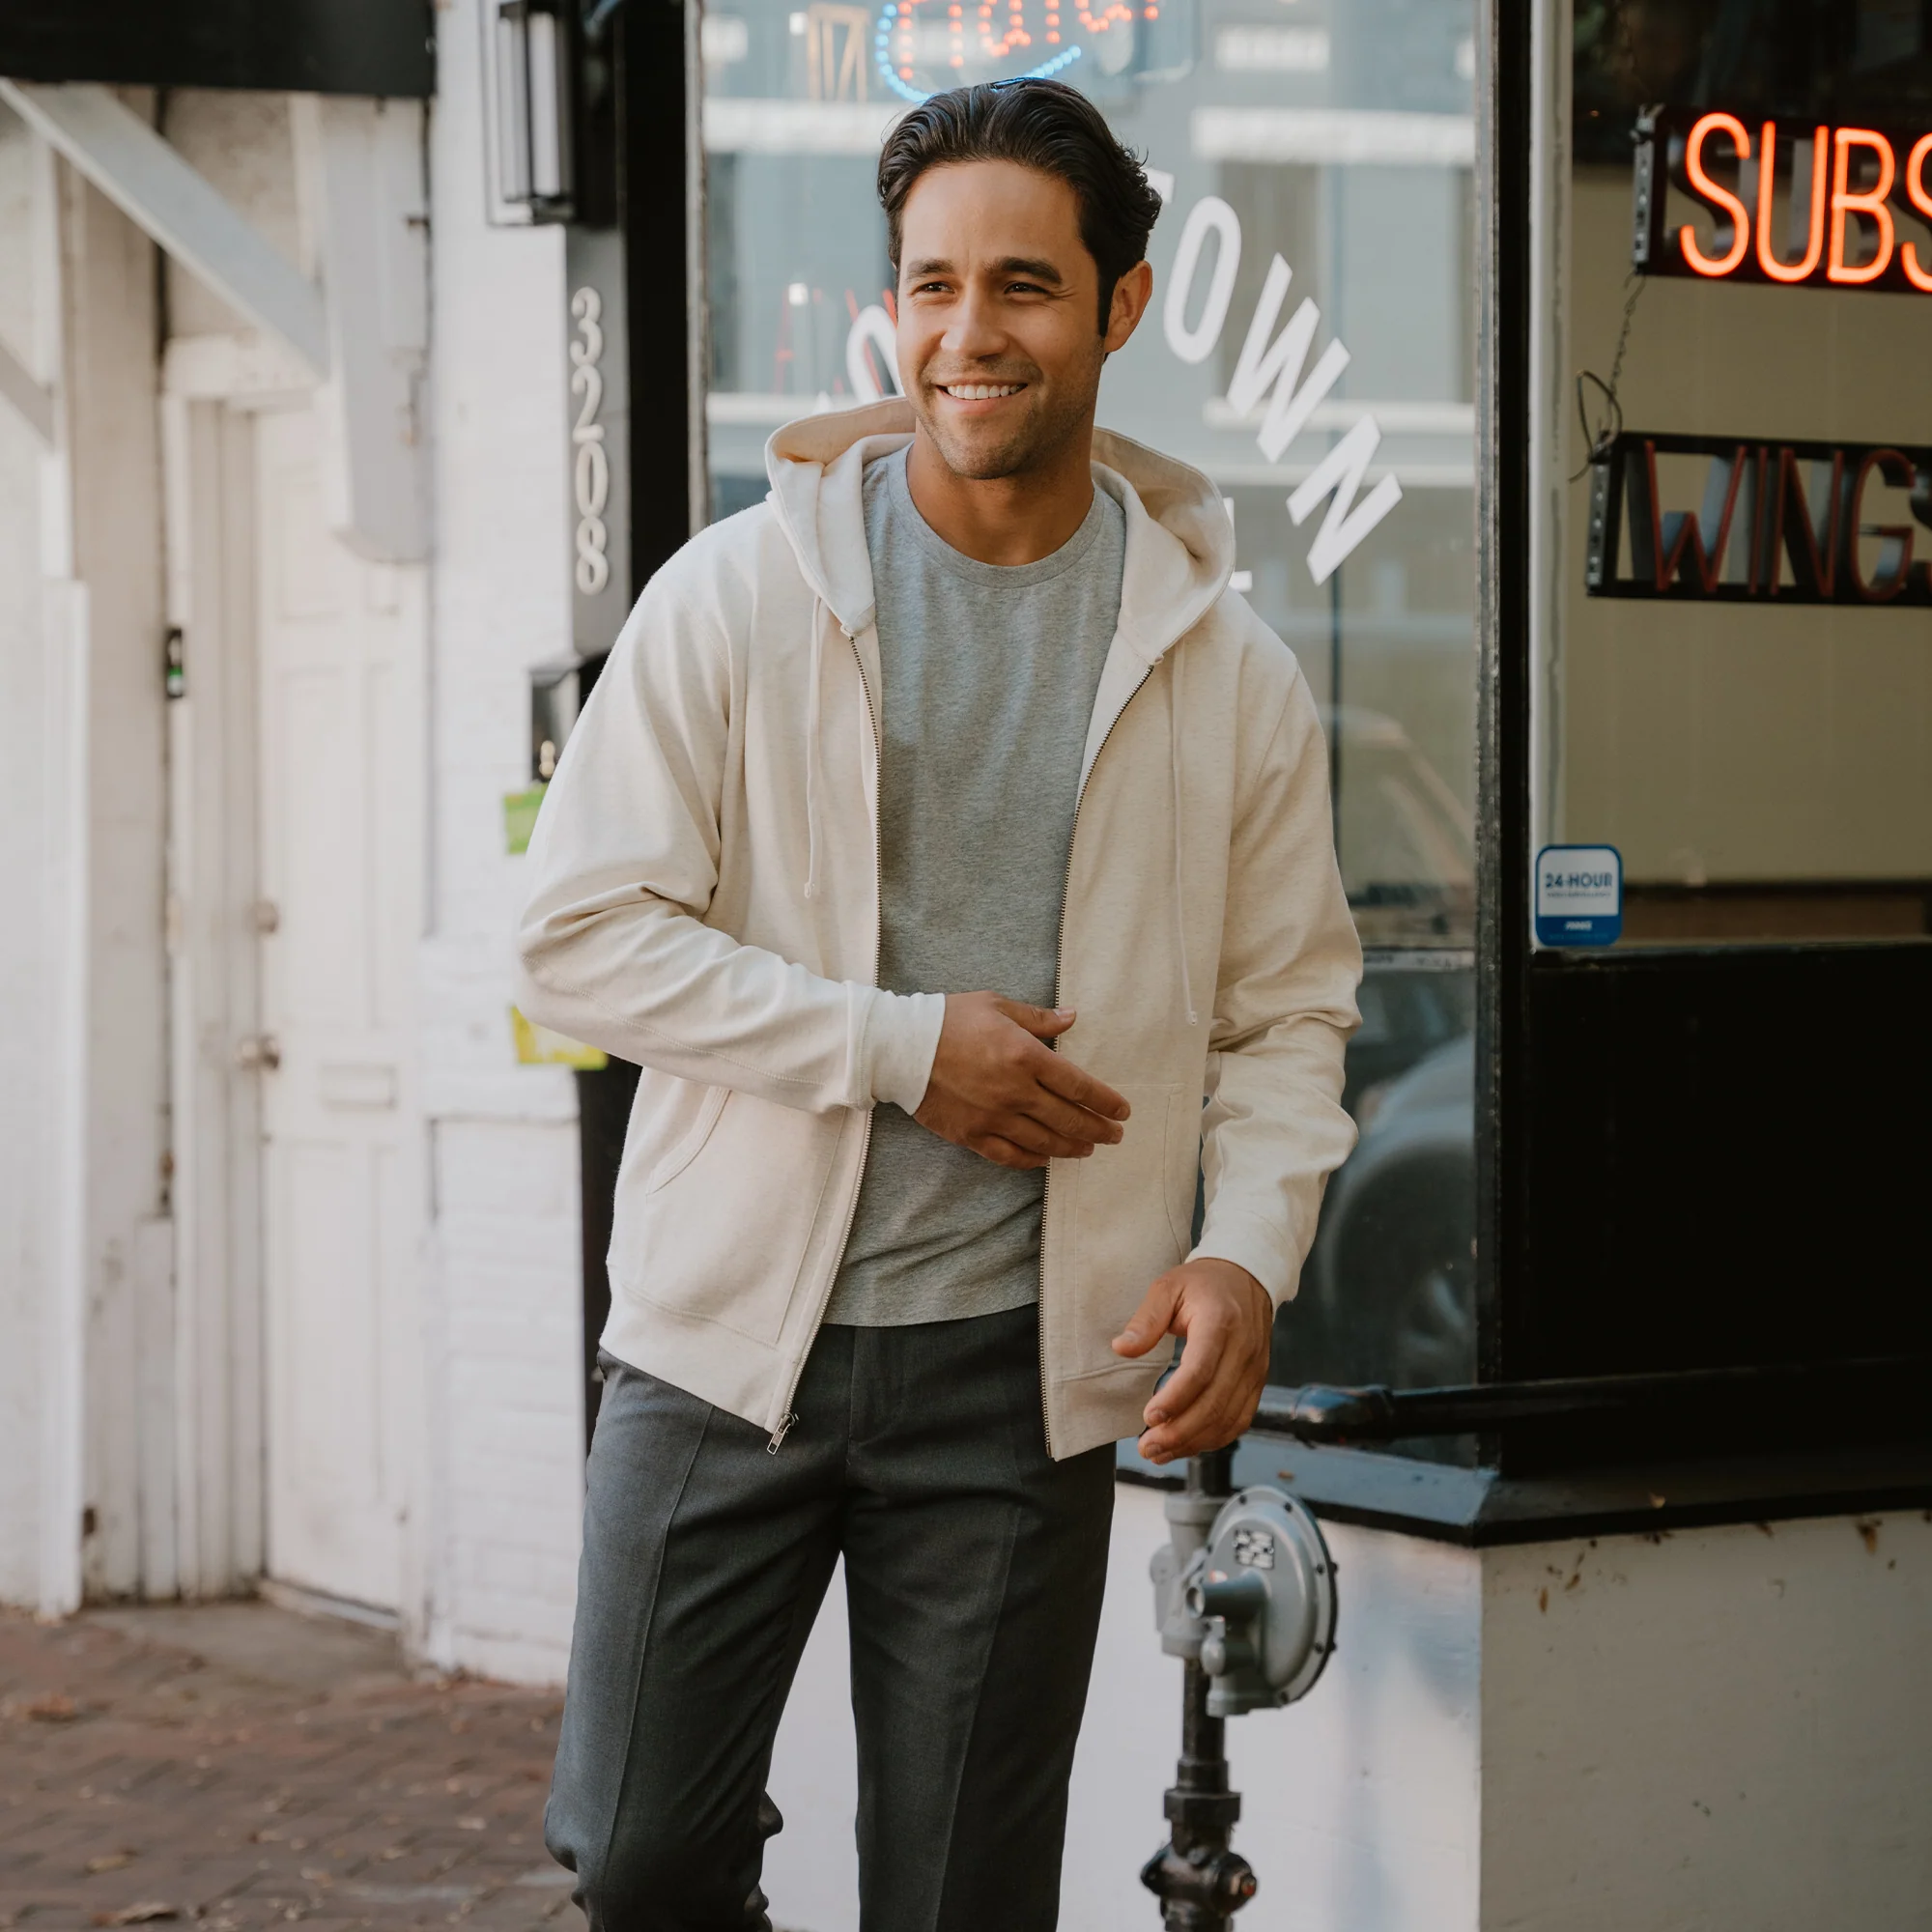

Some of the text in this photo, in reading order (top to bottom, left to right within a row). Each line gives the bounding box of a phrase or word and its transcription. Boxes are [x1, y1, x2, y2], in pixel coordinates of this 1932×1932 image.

[570, 286, 609, 595] 3208
[1645, 440, 1932, 600] WING
[1546, 872, 1613, 888] 24-HOUR
